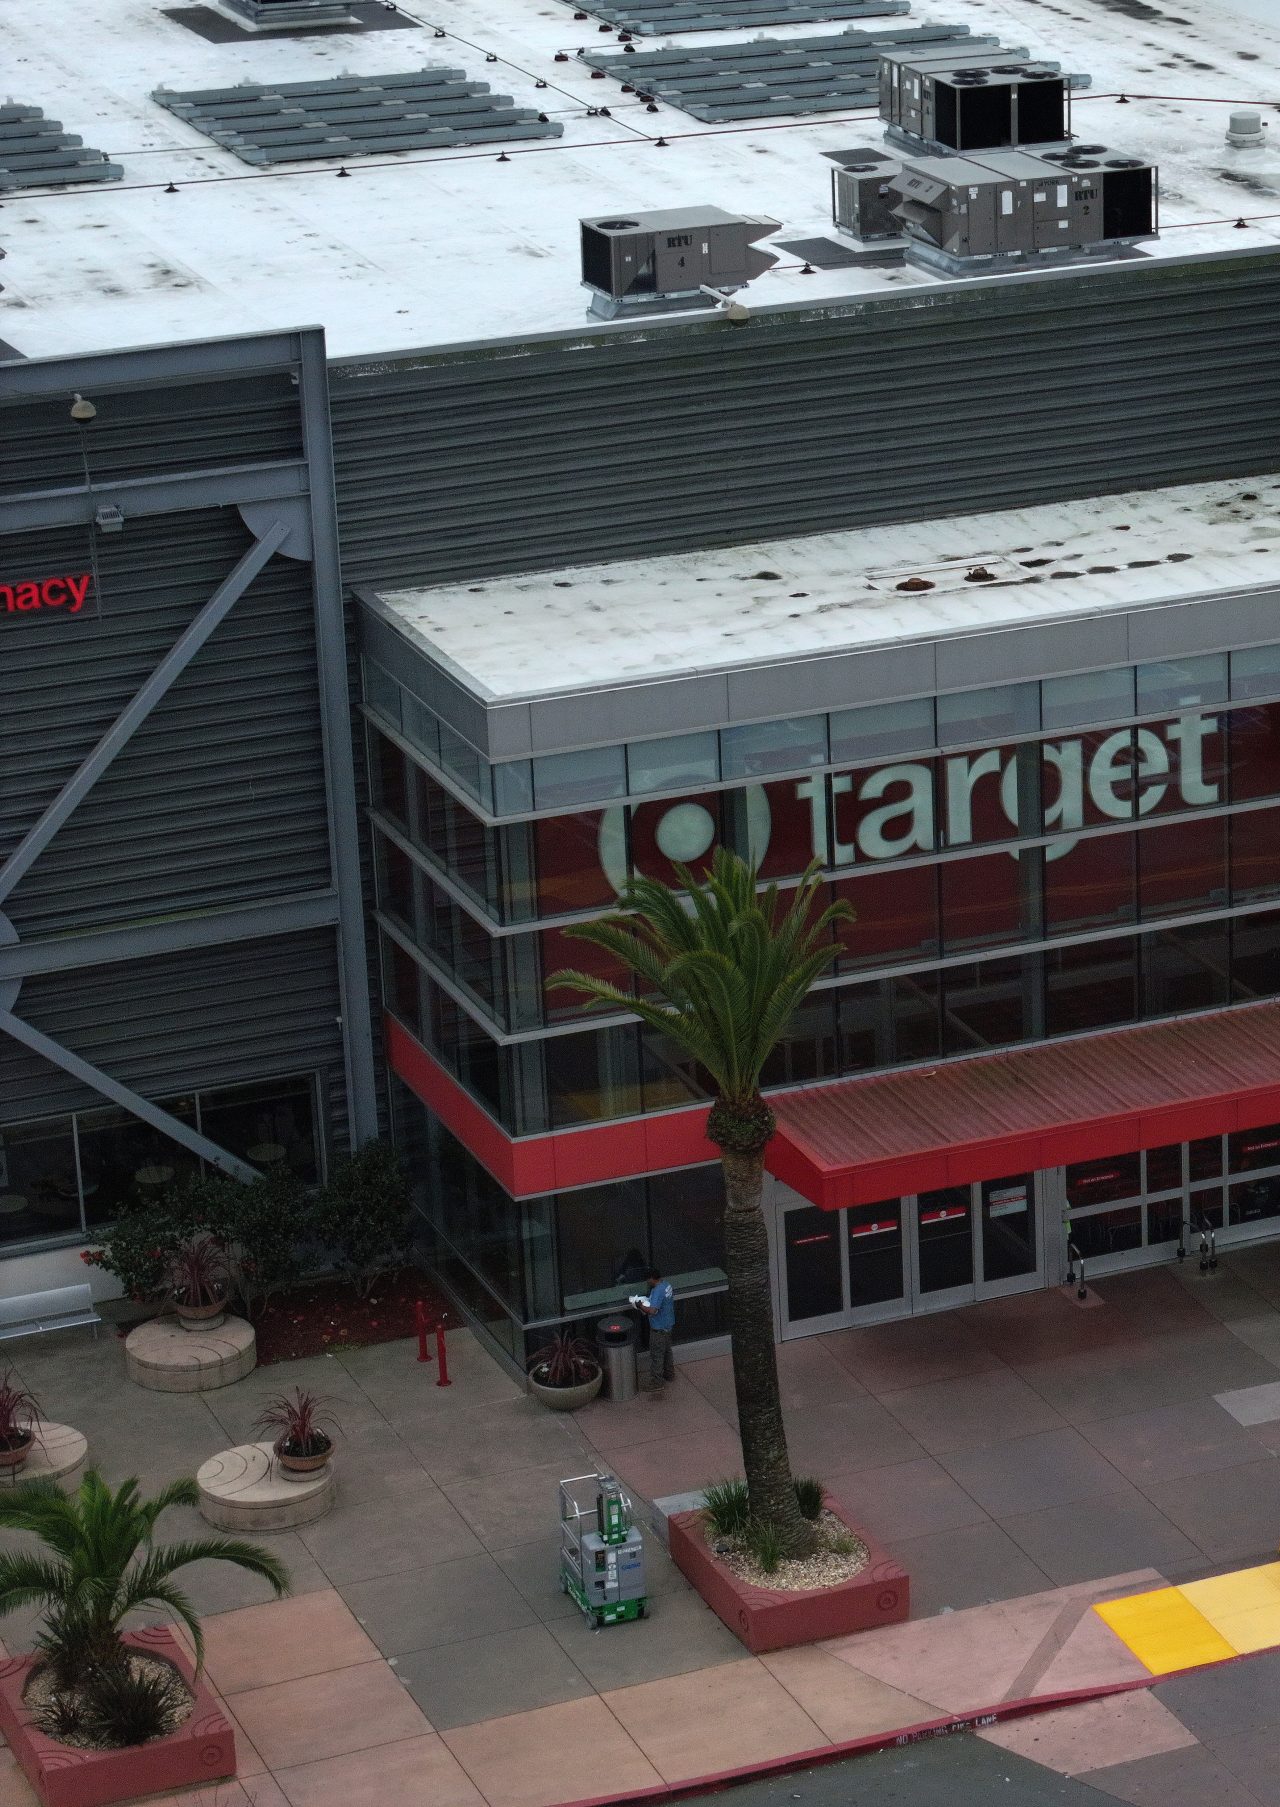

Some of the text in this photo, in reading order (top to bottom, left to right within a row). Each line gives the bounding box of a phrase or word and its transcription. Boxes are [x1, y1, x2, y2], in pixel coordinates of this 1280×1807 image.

[1073, 188, 1098, 201] RTU
[667, 234, 693, 249] RTU
[796, 696, 1219, 865] target
[895, 1734, 908, 1746] NO
